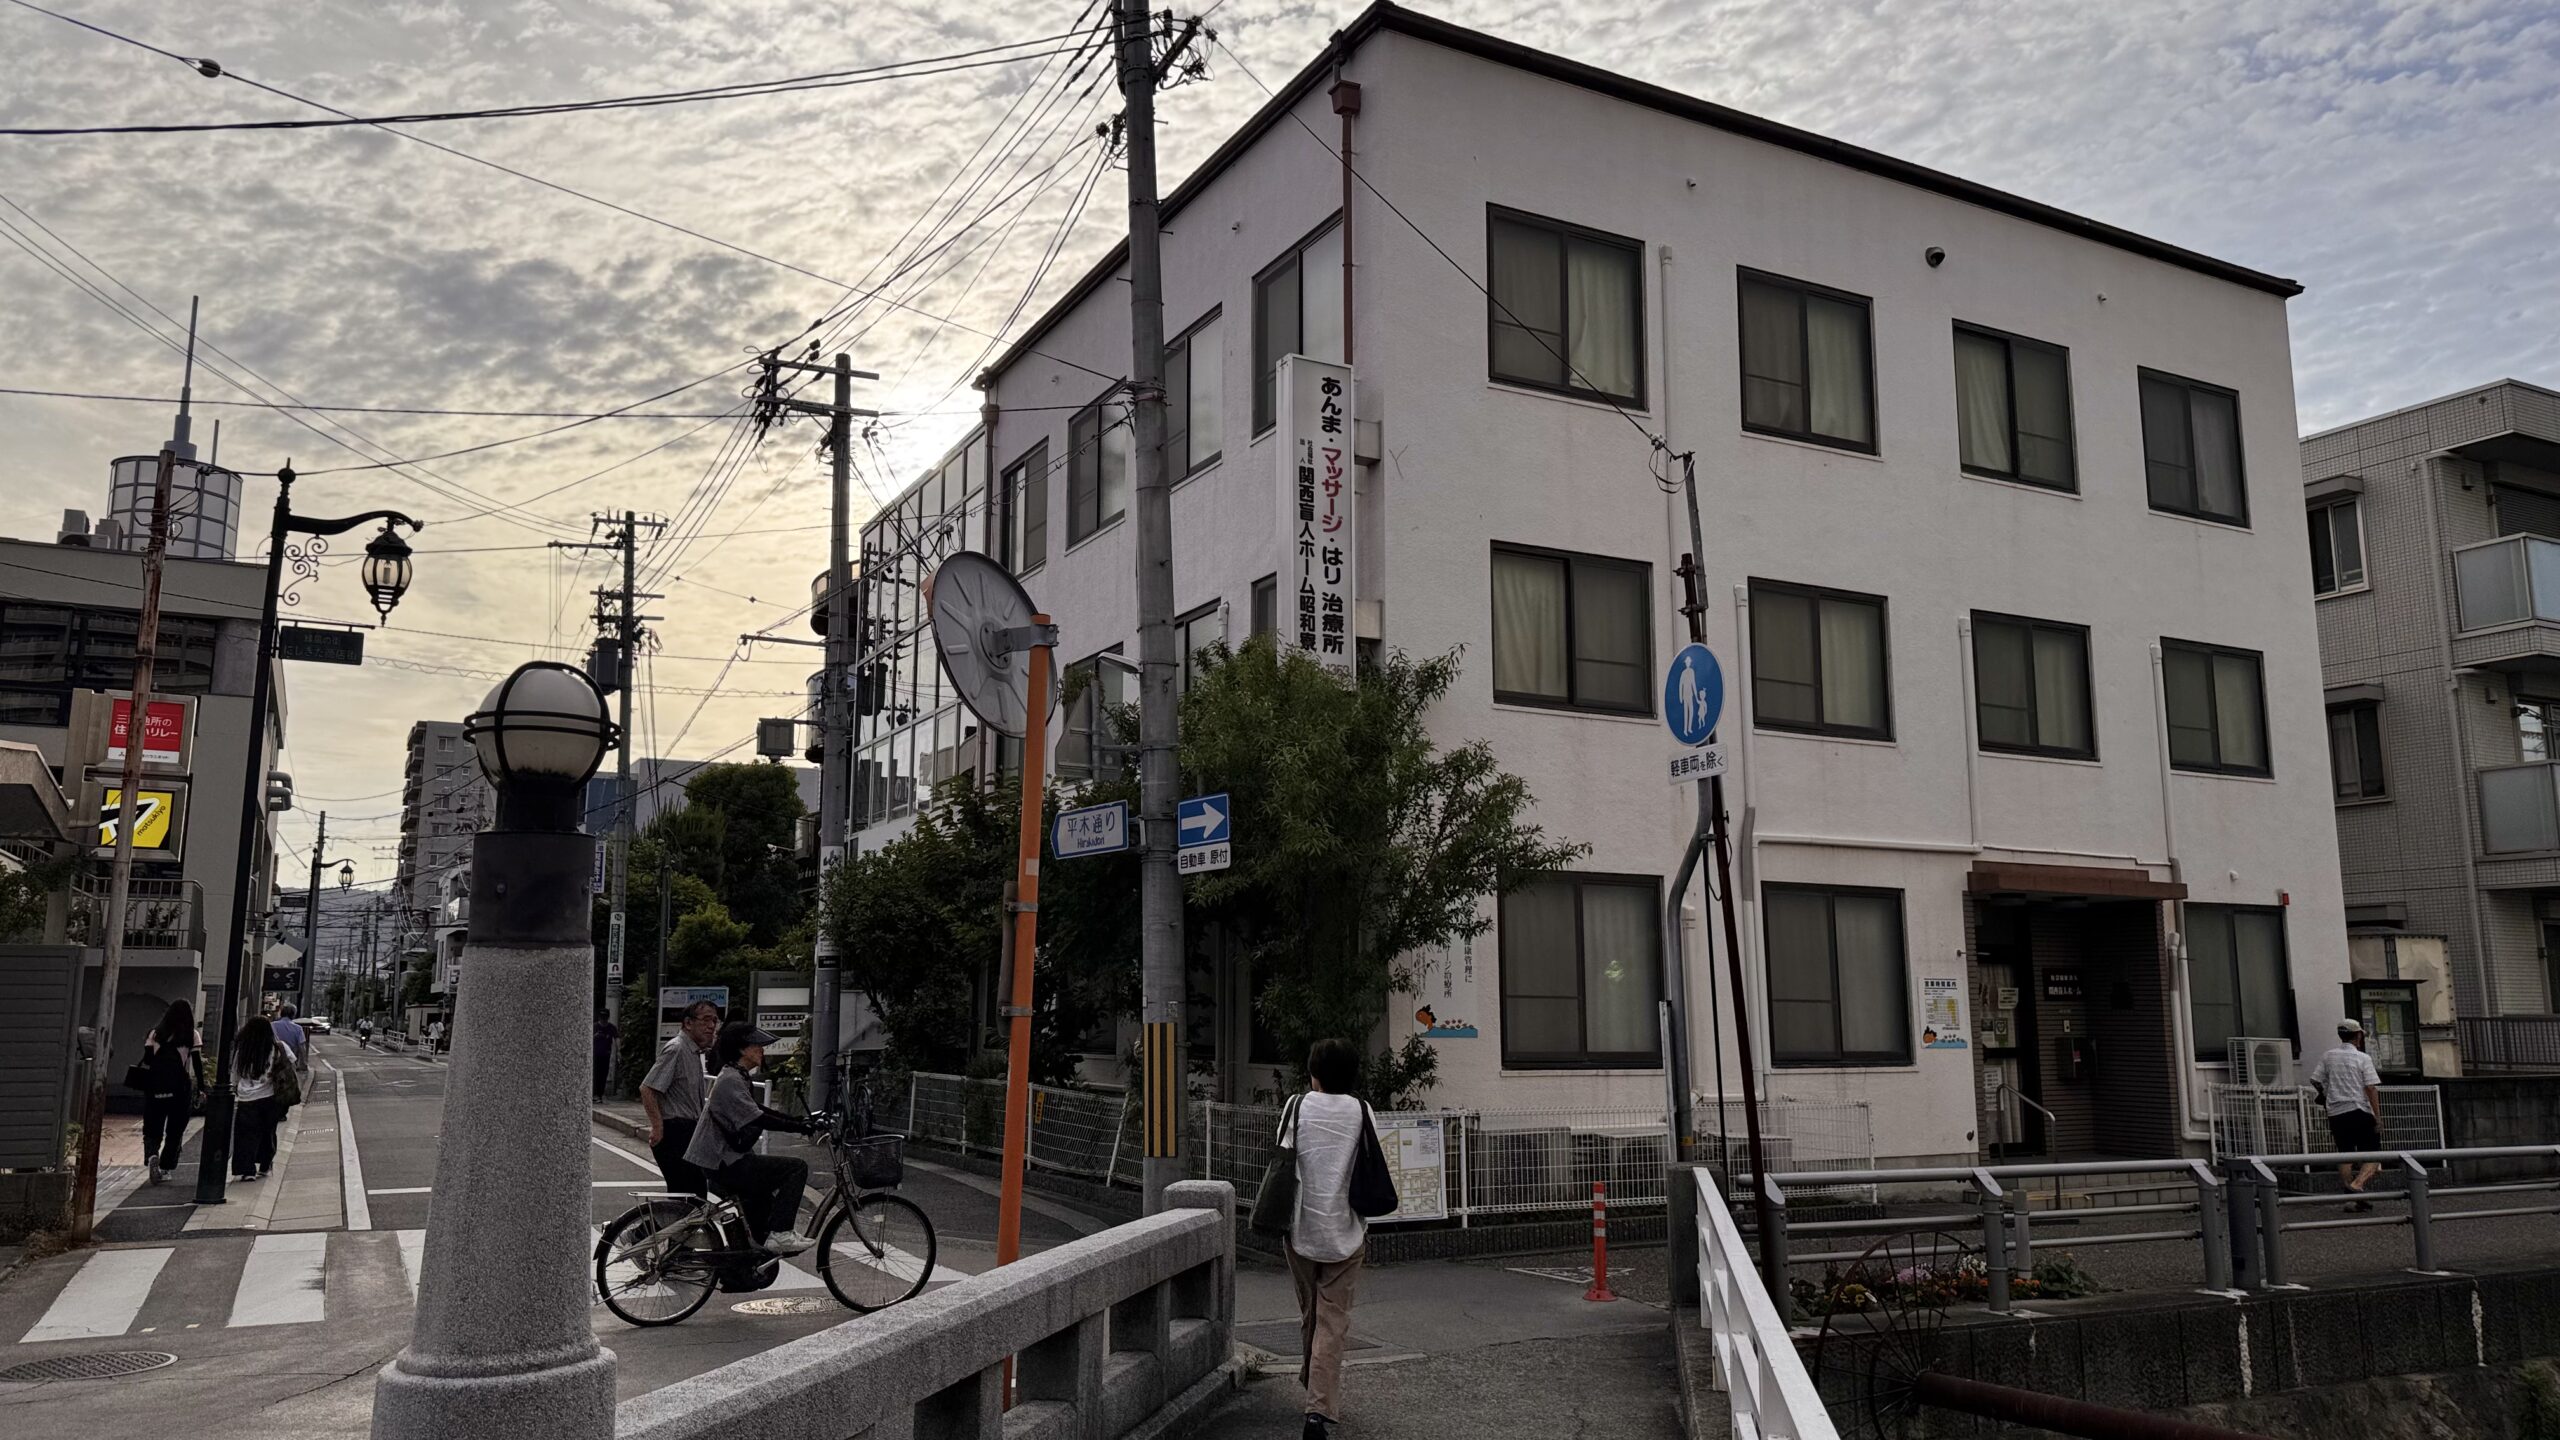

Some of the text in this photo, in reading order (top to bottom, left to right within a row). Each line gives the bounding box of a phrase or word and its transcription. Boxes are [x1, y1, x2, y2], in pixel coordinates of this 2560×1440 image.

[1670, 750, 1724, 778] 軽車両を除く
[137, 805, 166, 837] matsukiyo
[1067, 810, 1116, 838] 平木通り
